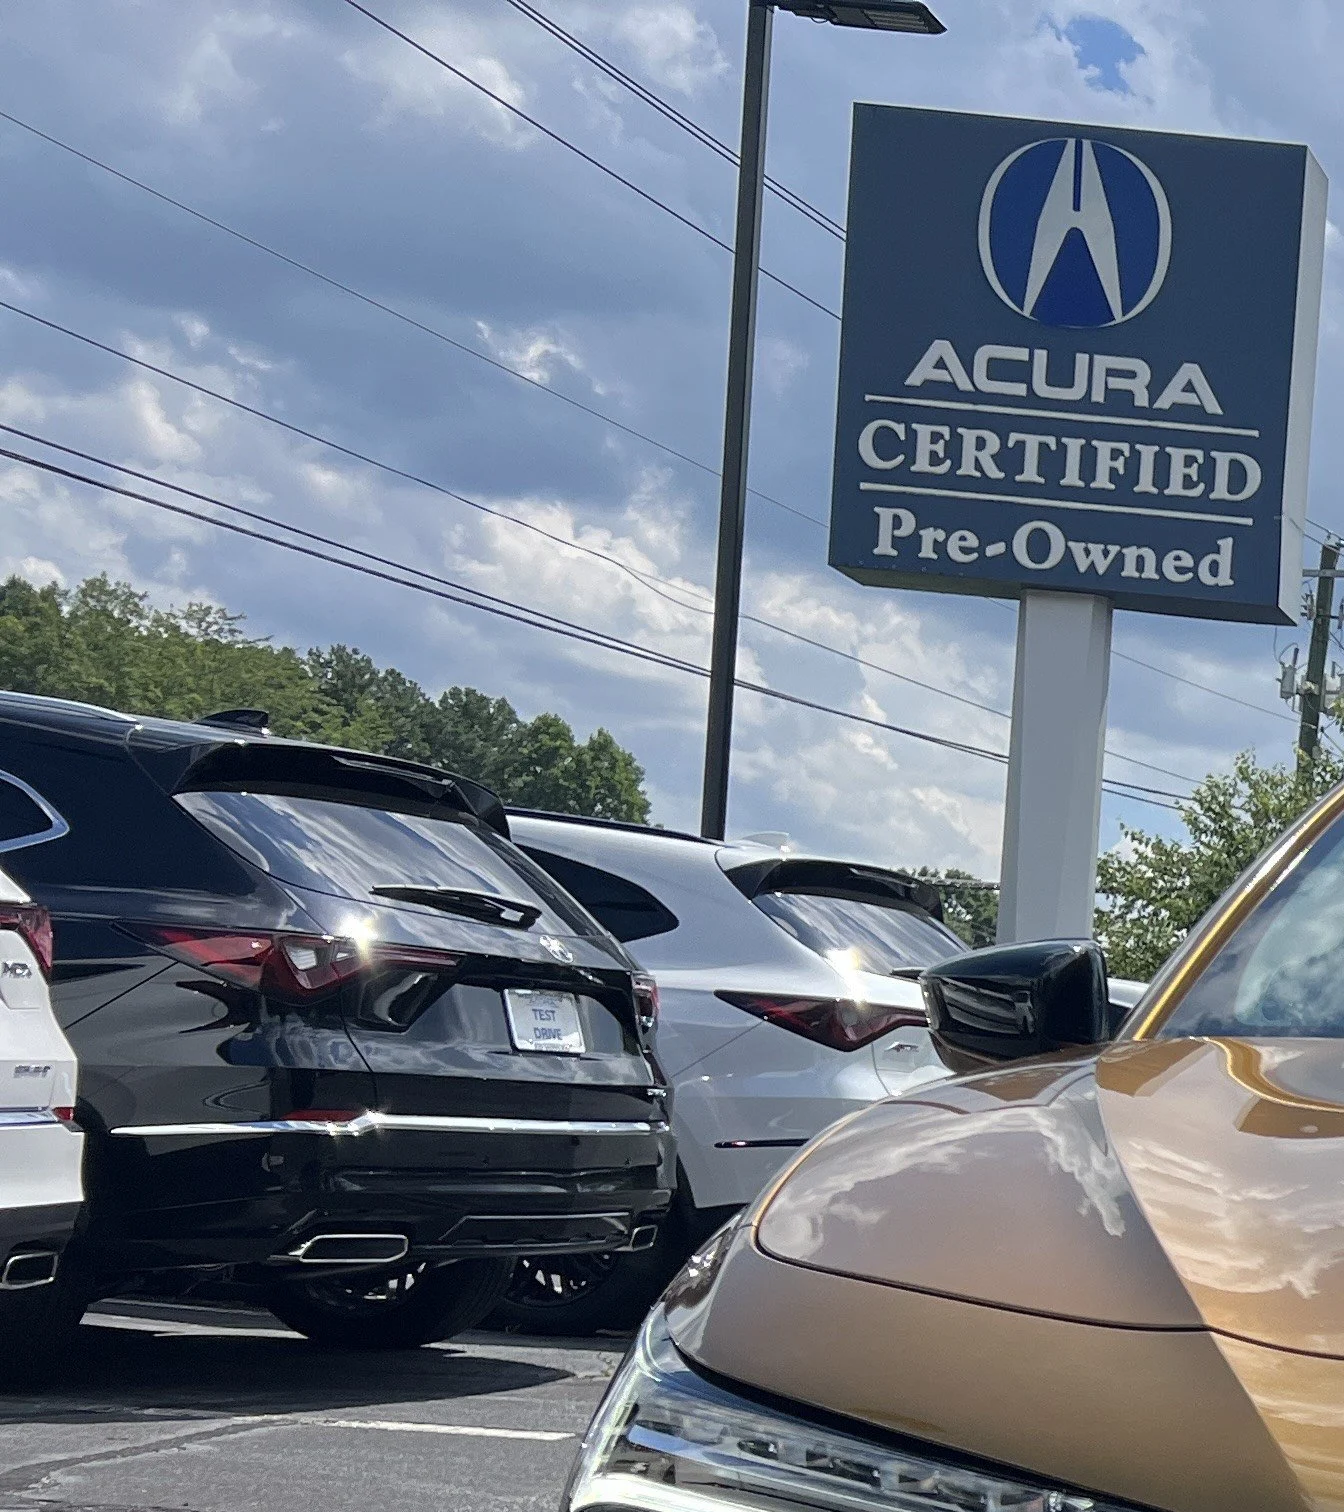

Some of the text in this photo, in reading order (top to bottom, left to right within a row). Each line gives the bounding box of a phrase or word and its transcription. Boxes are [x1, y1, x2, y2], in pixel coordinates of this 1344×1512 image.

[904, 339, 1224, 415] ACURA
[857, 419, 1262, 502] CERTIFIED
[871, 506, 1236, 588] Pre-Owned
[531, 1008, 556, 1021] TEST
[533, 1027, 563, 1041] DRIVE
